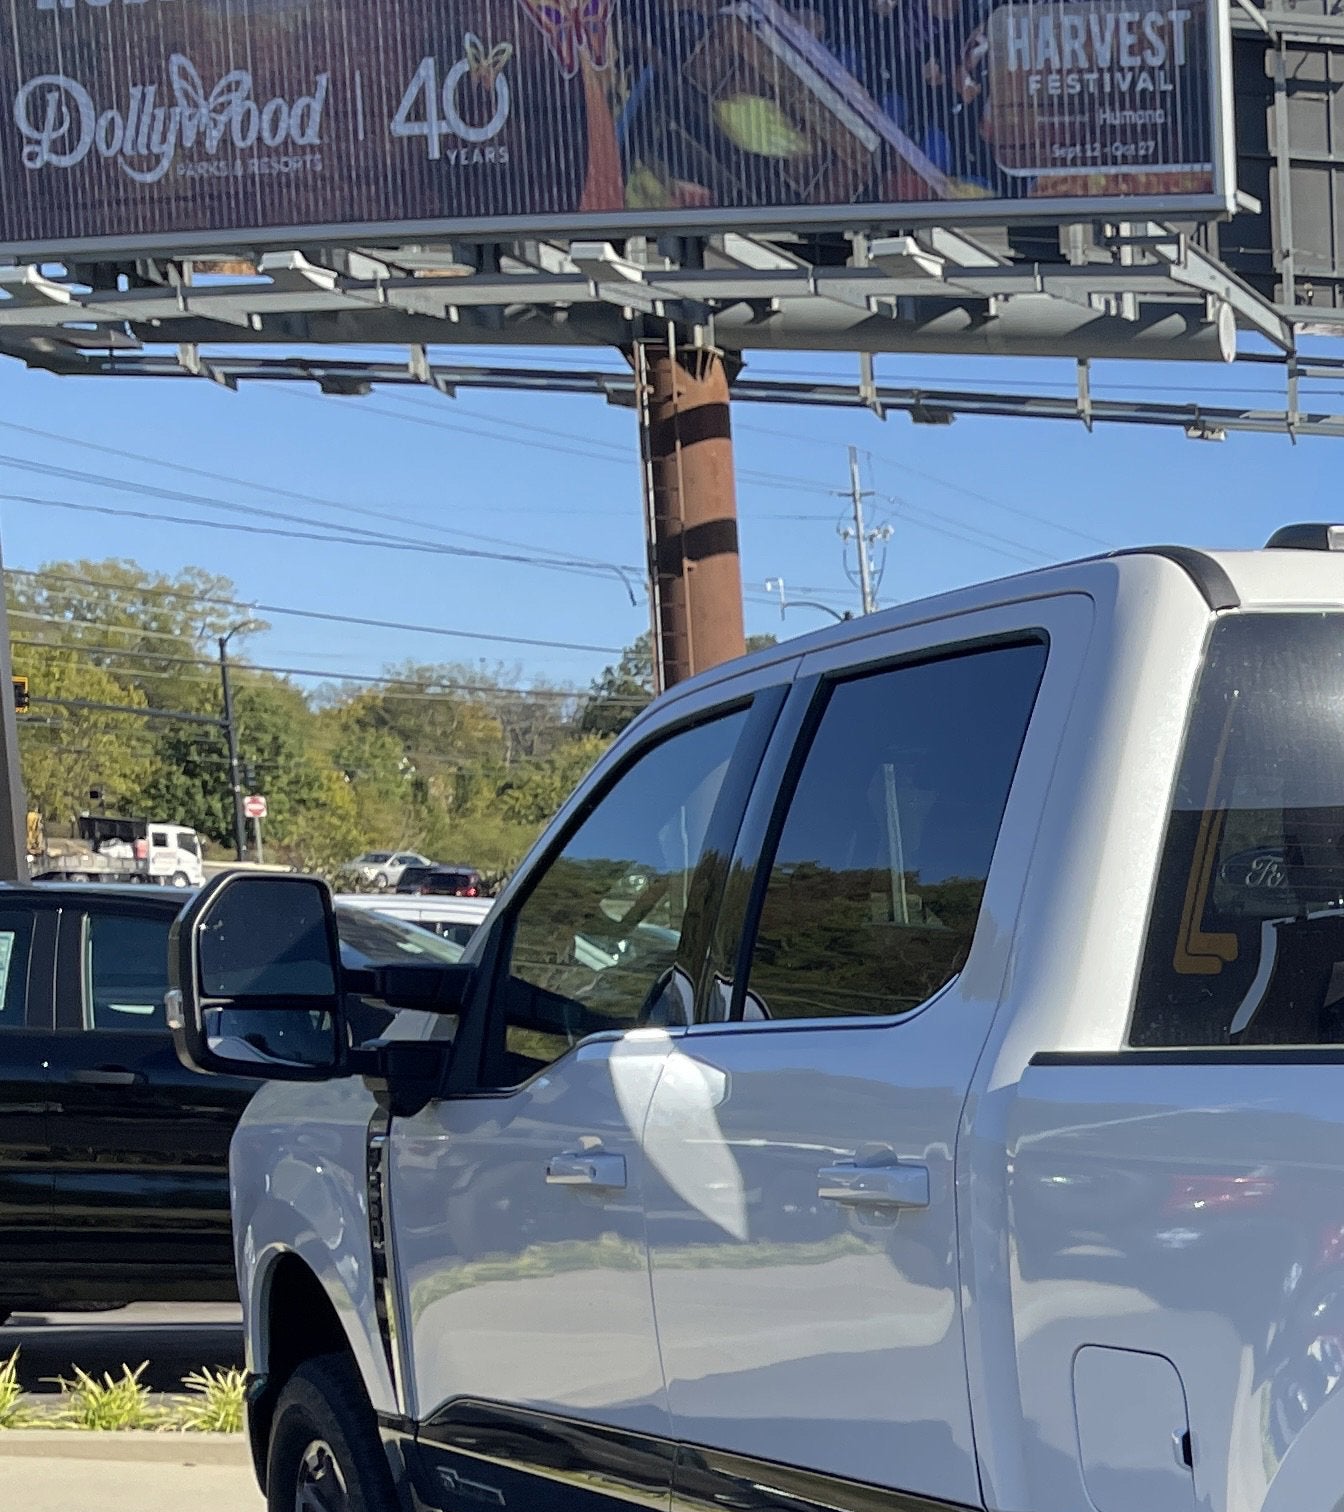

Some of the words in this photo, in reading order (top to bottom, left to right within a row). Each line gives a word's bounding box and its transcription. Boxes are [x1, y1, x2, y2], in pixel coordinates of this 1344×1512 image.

[1007, 9, 1192, 71] HARVEST
[390, 55, 511, 160] 40
[1028, 70, 1174, 96] FESTIVAL
[13, 53, 329, 184] Dollywood
[446, 146, 510, 166] YEARS
